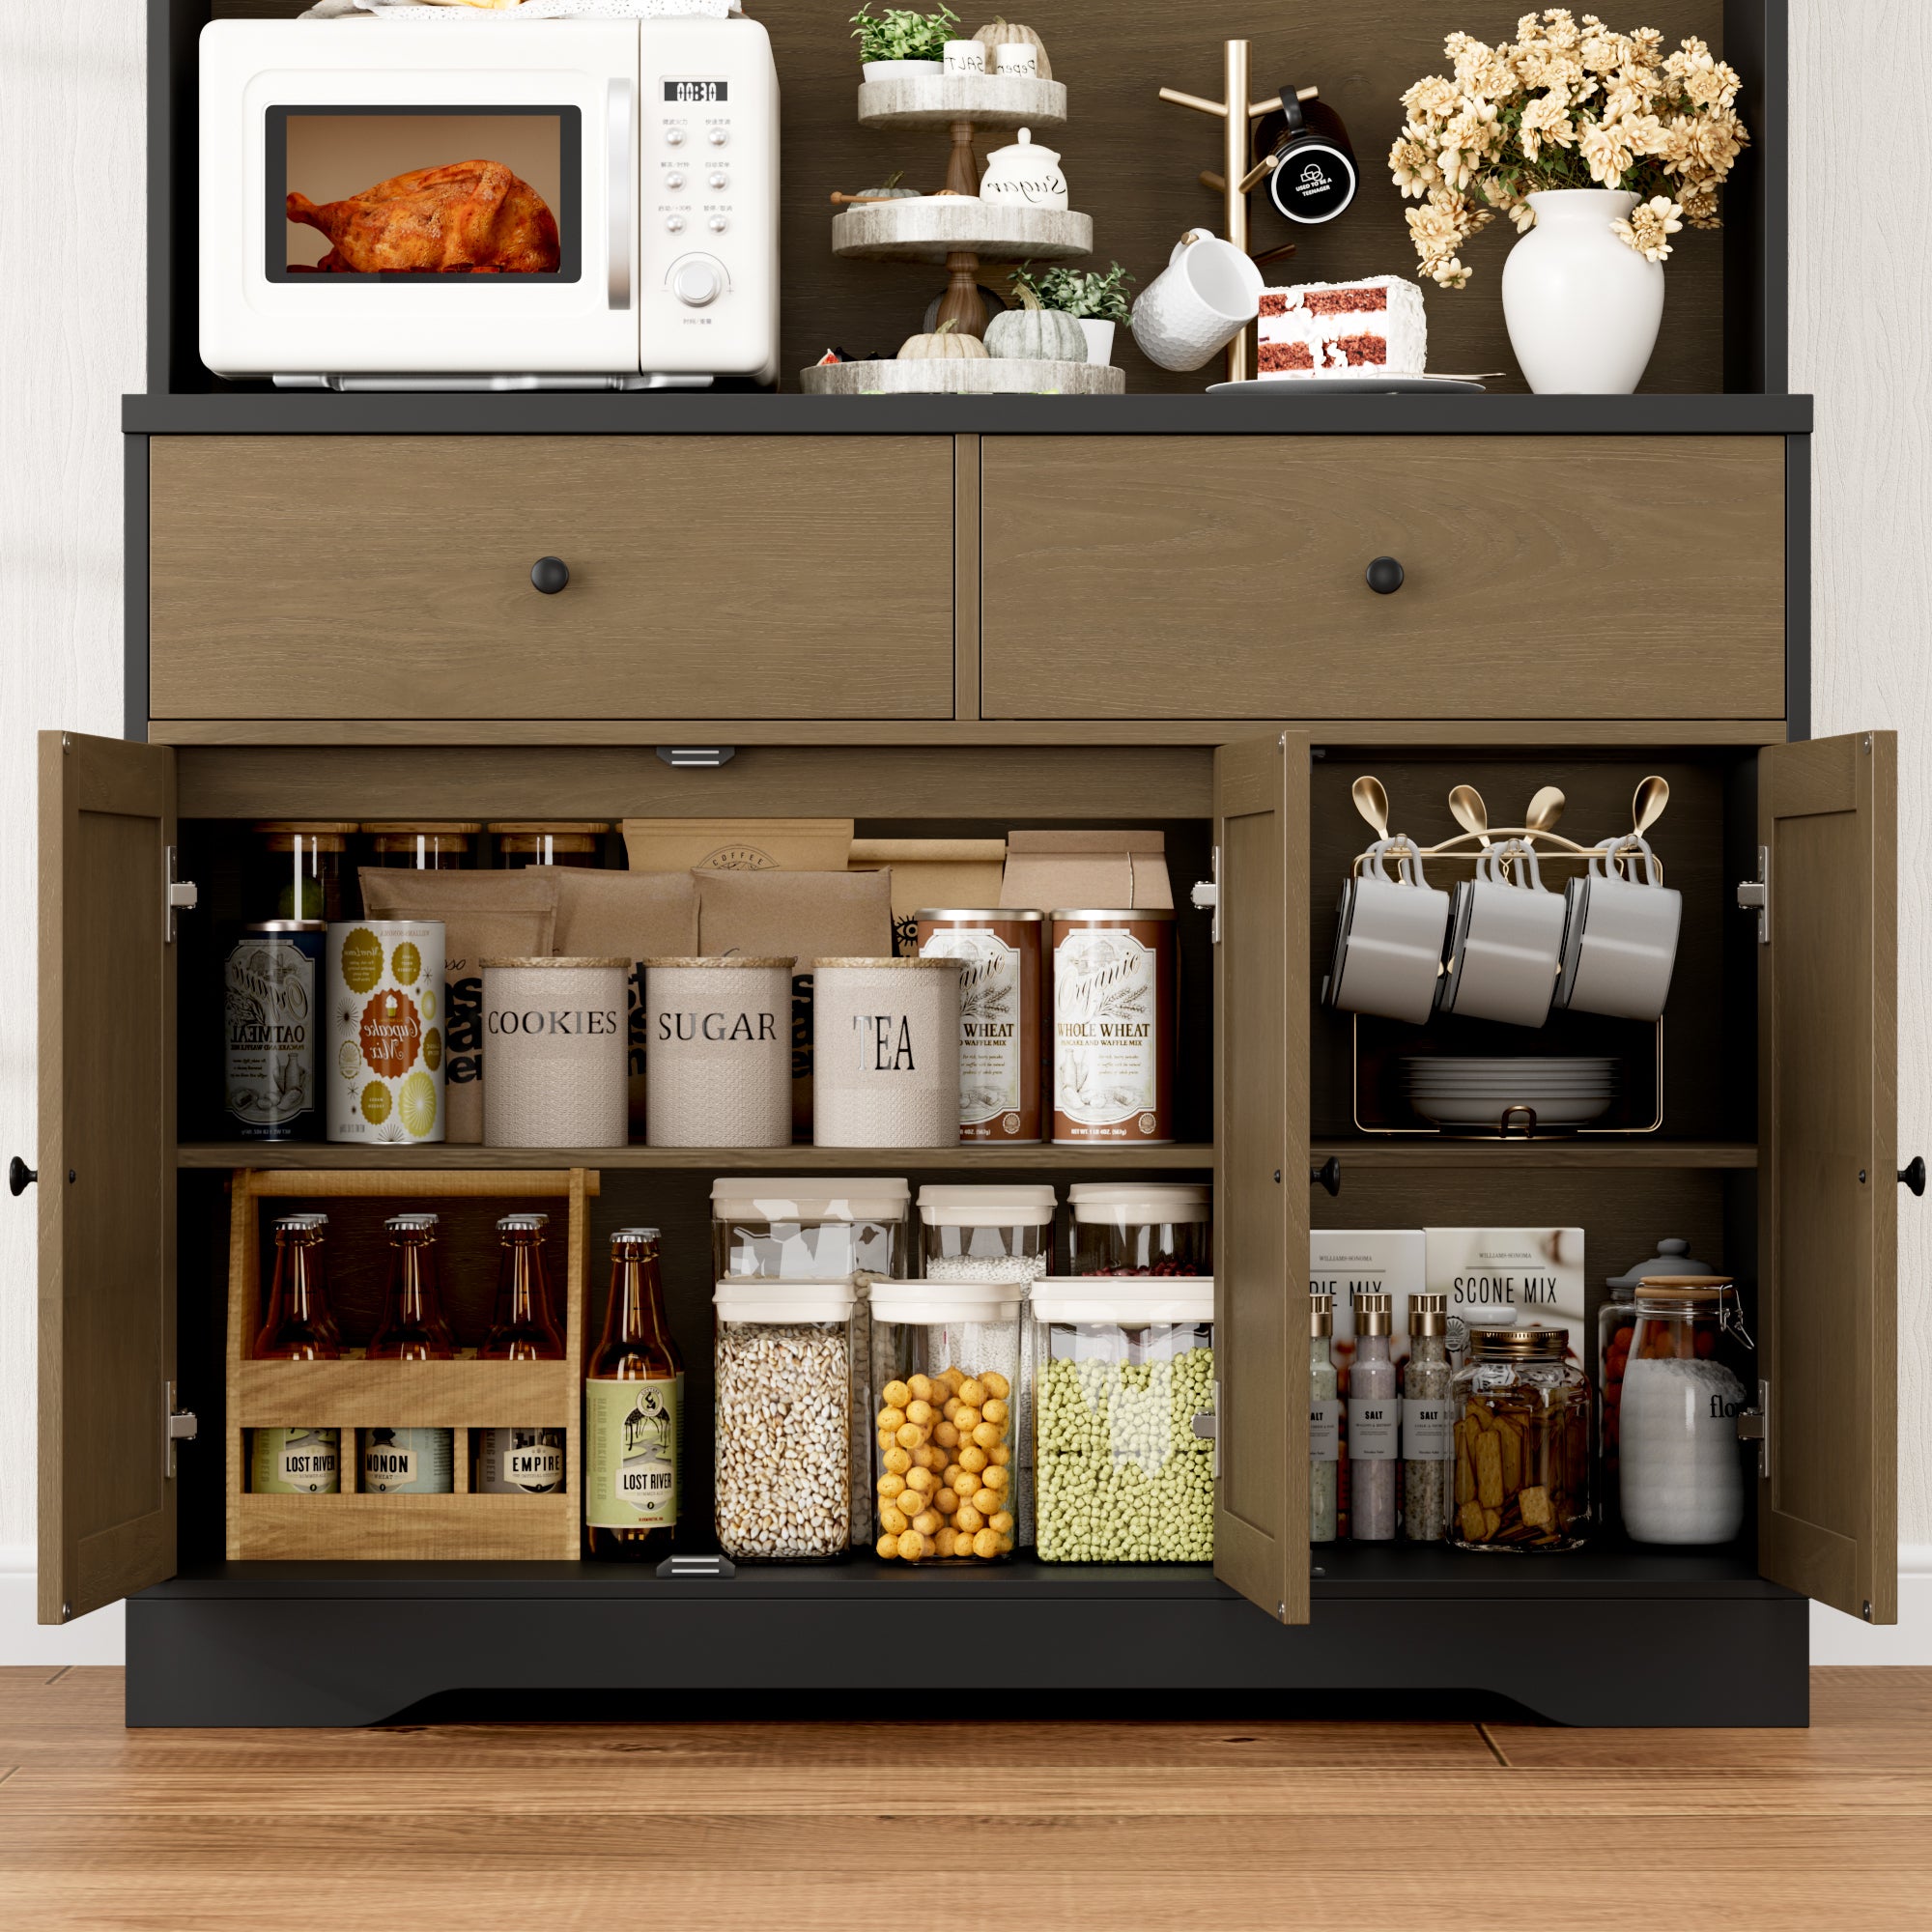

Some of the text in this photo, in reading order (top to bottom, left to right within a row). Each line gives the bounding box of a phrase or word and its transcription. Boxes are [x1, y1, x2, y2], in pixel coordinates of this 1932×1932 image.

[676, 82, 718, 101] 00:30
[1302, 185, 1330, 196] TEENAGER
[712, 851, 764, 867] COFFEE
[489, 1010, 617, 1036] COOKIES
[659, 1012, 778, 1041] SUGAR
[963, 1023, 1014, 1037] WHEAT
[1057, 1023, 1151, 1037] WHOLE WHEAT
[853, 1015, 915, 1070] TEA
[1454, 1277, 1557, 1303] SCONE MIX
[1710, 1394, 1740, 1418] flo
[1310, 1412, 1323, 1421] ALT
[1365, 1410, 1383, 1420] SALT
[1420, 1411, 1438, 1420] SALT
[286, 1455, 335, 1472] LOST RIVER
[512, 1455, 560, 1471] EMPIRE
[623, 1473, 672, 1490] LOST RIVER
